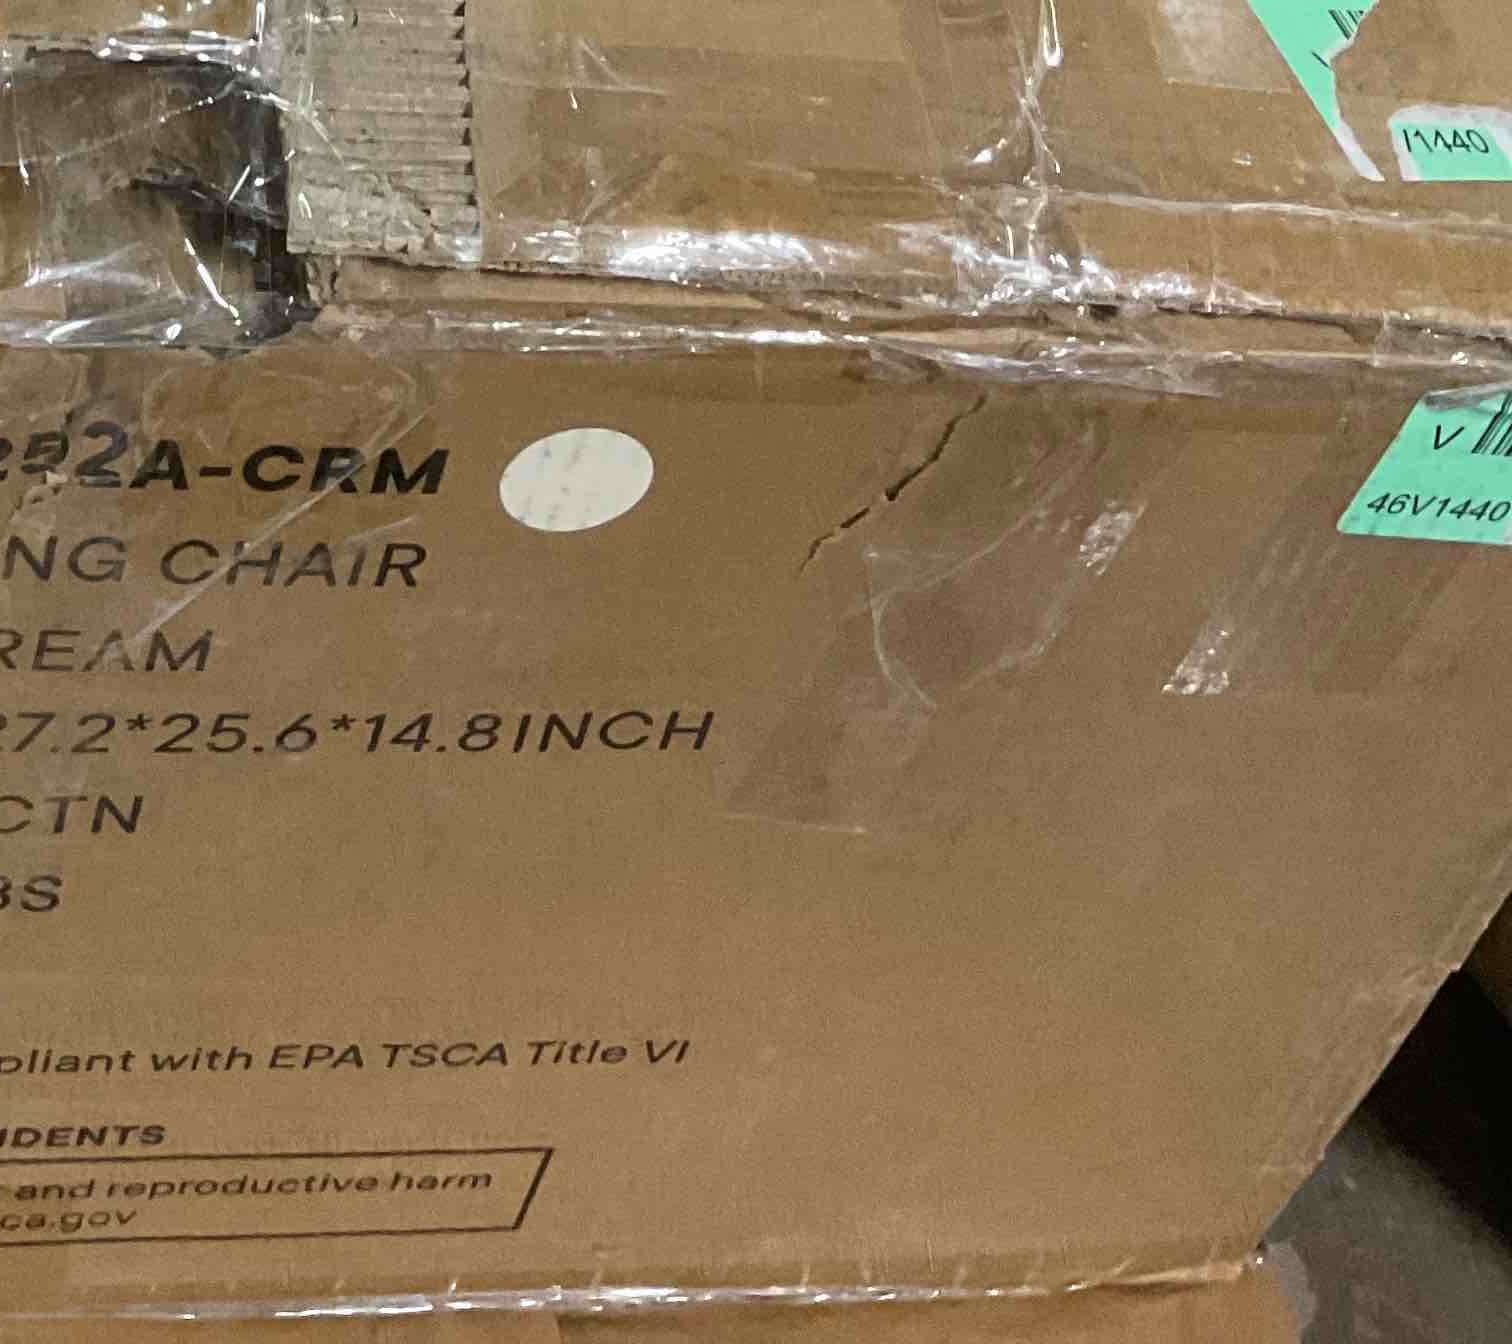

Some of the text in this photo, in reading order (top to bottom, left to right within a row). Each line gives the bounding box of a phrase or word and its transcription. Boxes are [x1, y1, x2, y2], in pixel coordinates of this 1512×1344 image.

[1433, 424, 1465, 451] V
[1366, 493, 1512, 523] 46V1440
[161, 540, 429, 587] CHAIR
[151, 1043, 254, 1073] with
[268, 1043, 365, 1069] EPA
[382, 1041, 508, 1069] TSCA
[527, 1038, 628, 1066] Title
[644, 1039, 690, 1066] VI
[13, 1179, 97, 1203] and
[106, 1171, 380, 1201] reproductive
[389, 1168, 493, 1194] harm
